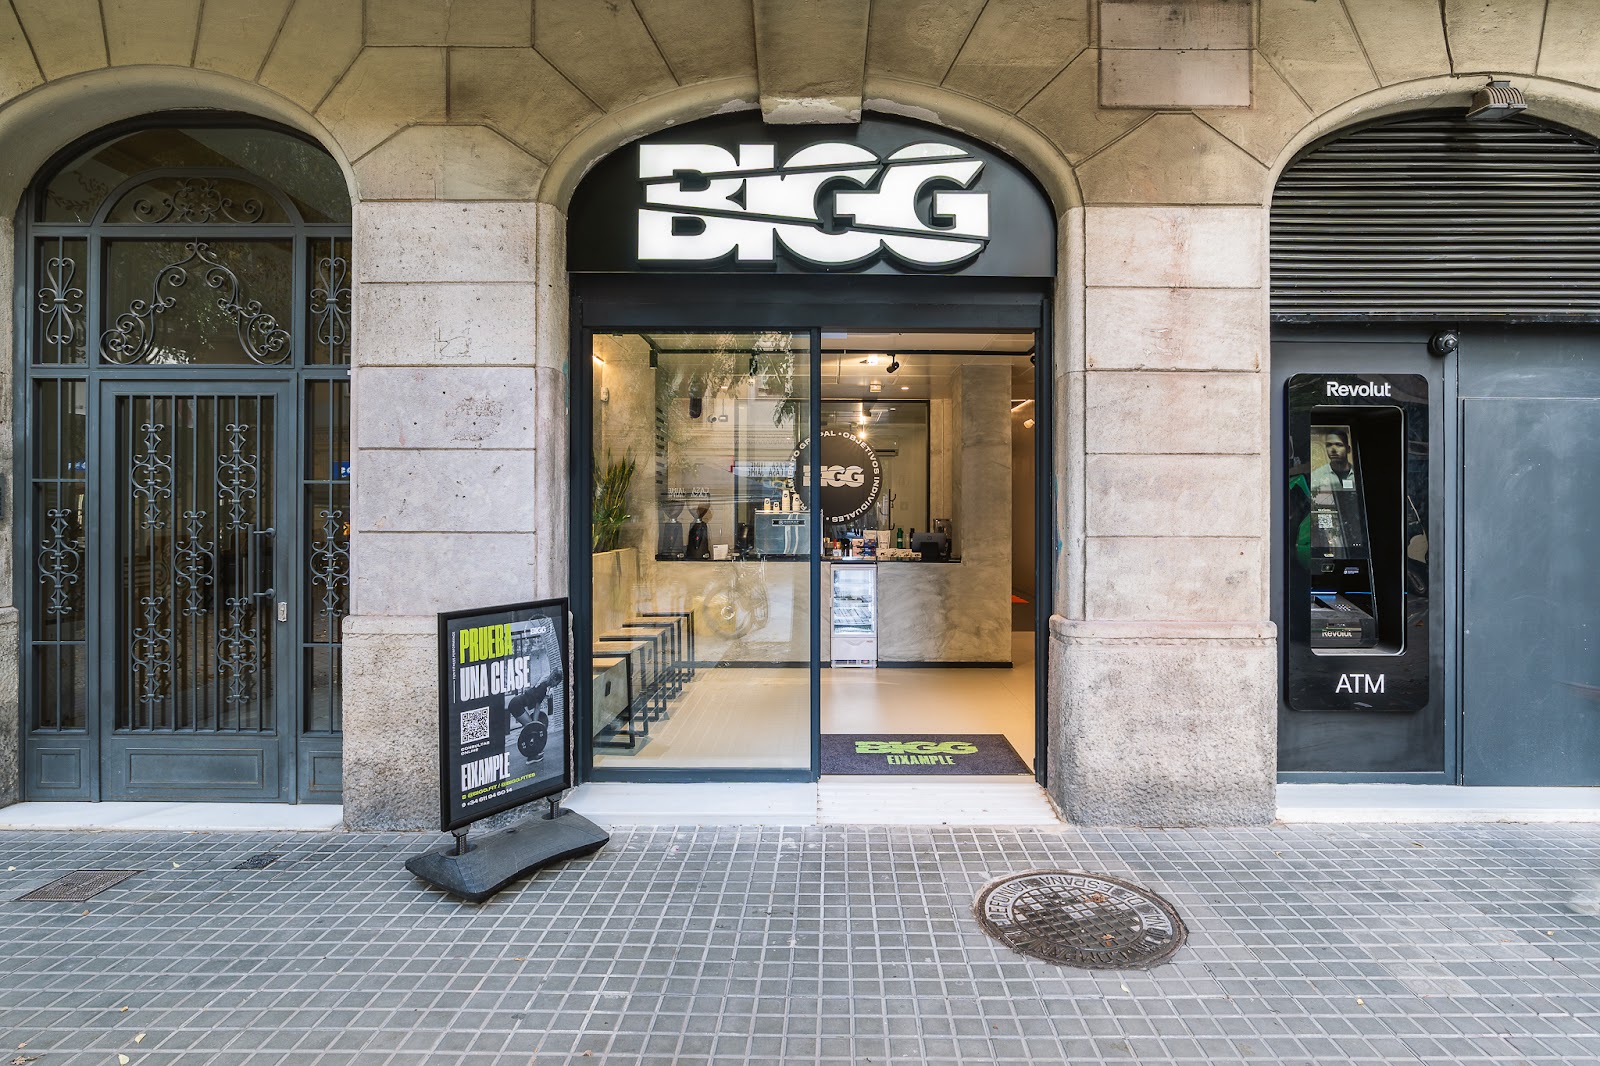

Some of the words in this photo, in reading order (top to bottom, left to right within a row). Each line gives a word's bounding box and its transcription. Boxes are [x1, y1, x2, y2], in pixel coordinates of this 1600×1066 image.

[636, 142, 991, 266] BIGG
[1326, 381, 1392, 397] Revolut
[842, 431, 881, 475] OBJETIVOS
[831, 476, 881, 523] INDIVIDUALES
[530, 626, 547, 635] BIGG
[1322, 629, 1353, 638] Revolut
[459, 623, 514, 664] PRUEBA
[459, 663, 489, 702] UNA
[490, 655, 531, 695] CLASE
[1335, 674, 1386, 694] ATM
[460, 747, 479, 756] ONLINE
[854, 741, 979, 755] BIGG
[886, 755, 956, 765] EIXAMPLE
[460, 752, 511, 792] EIXAMPLE
[1123, 892, 1144, 906] DE
